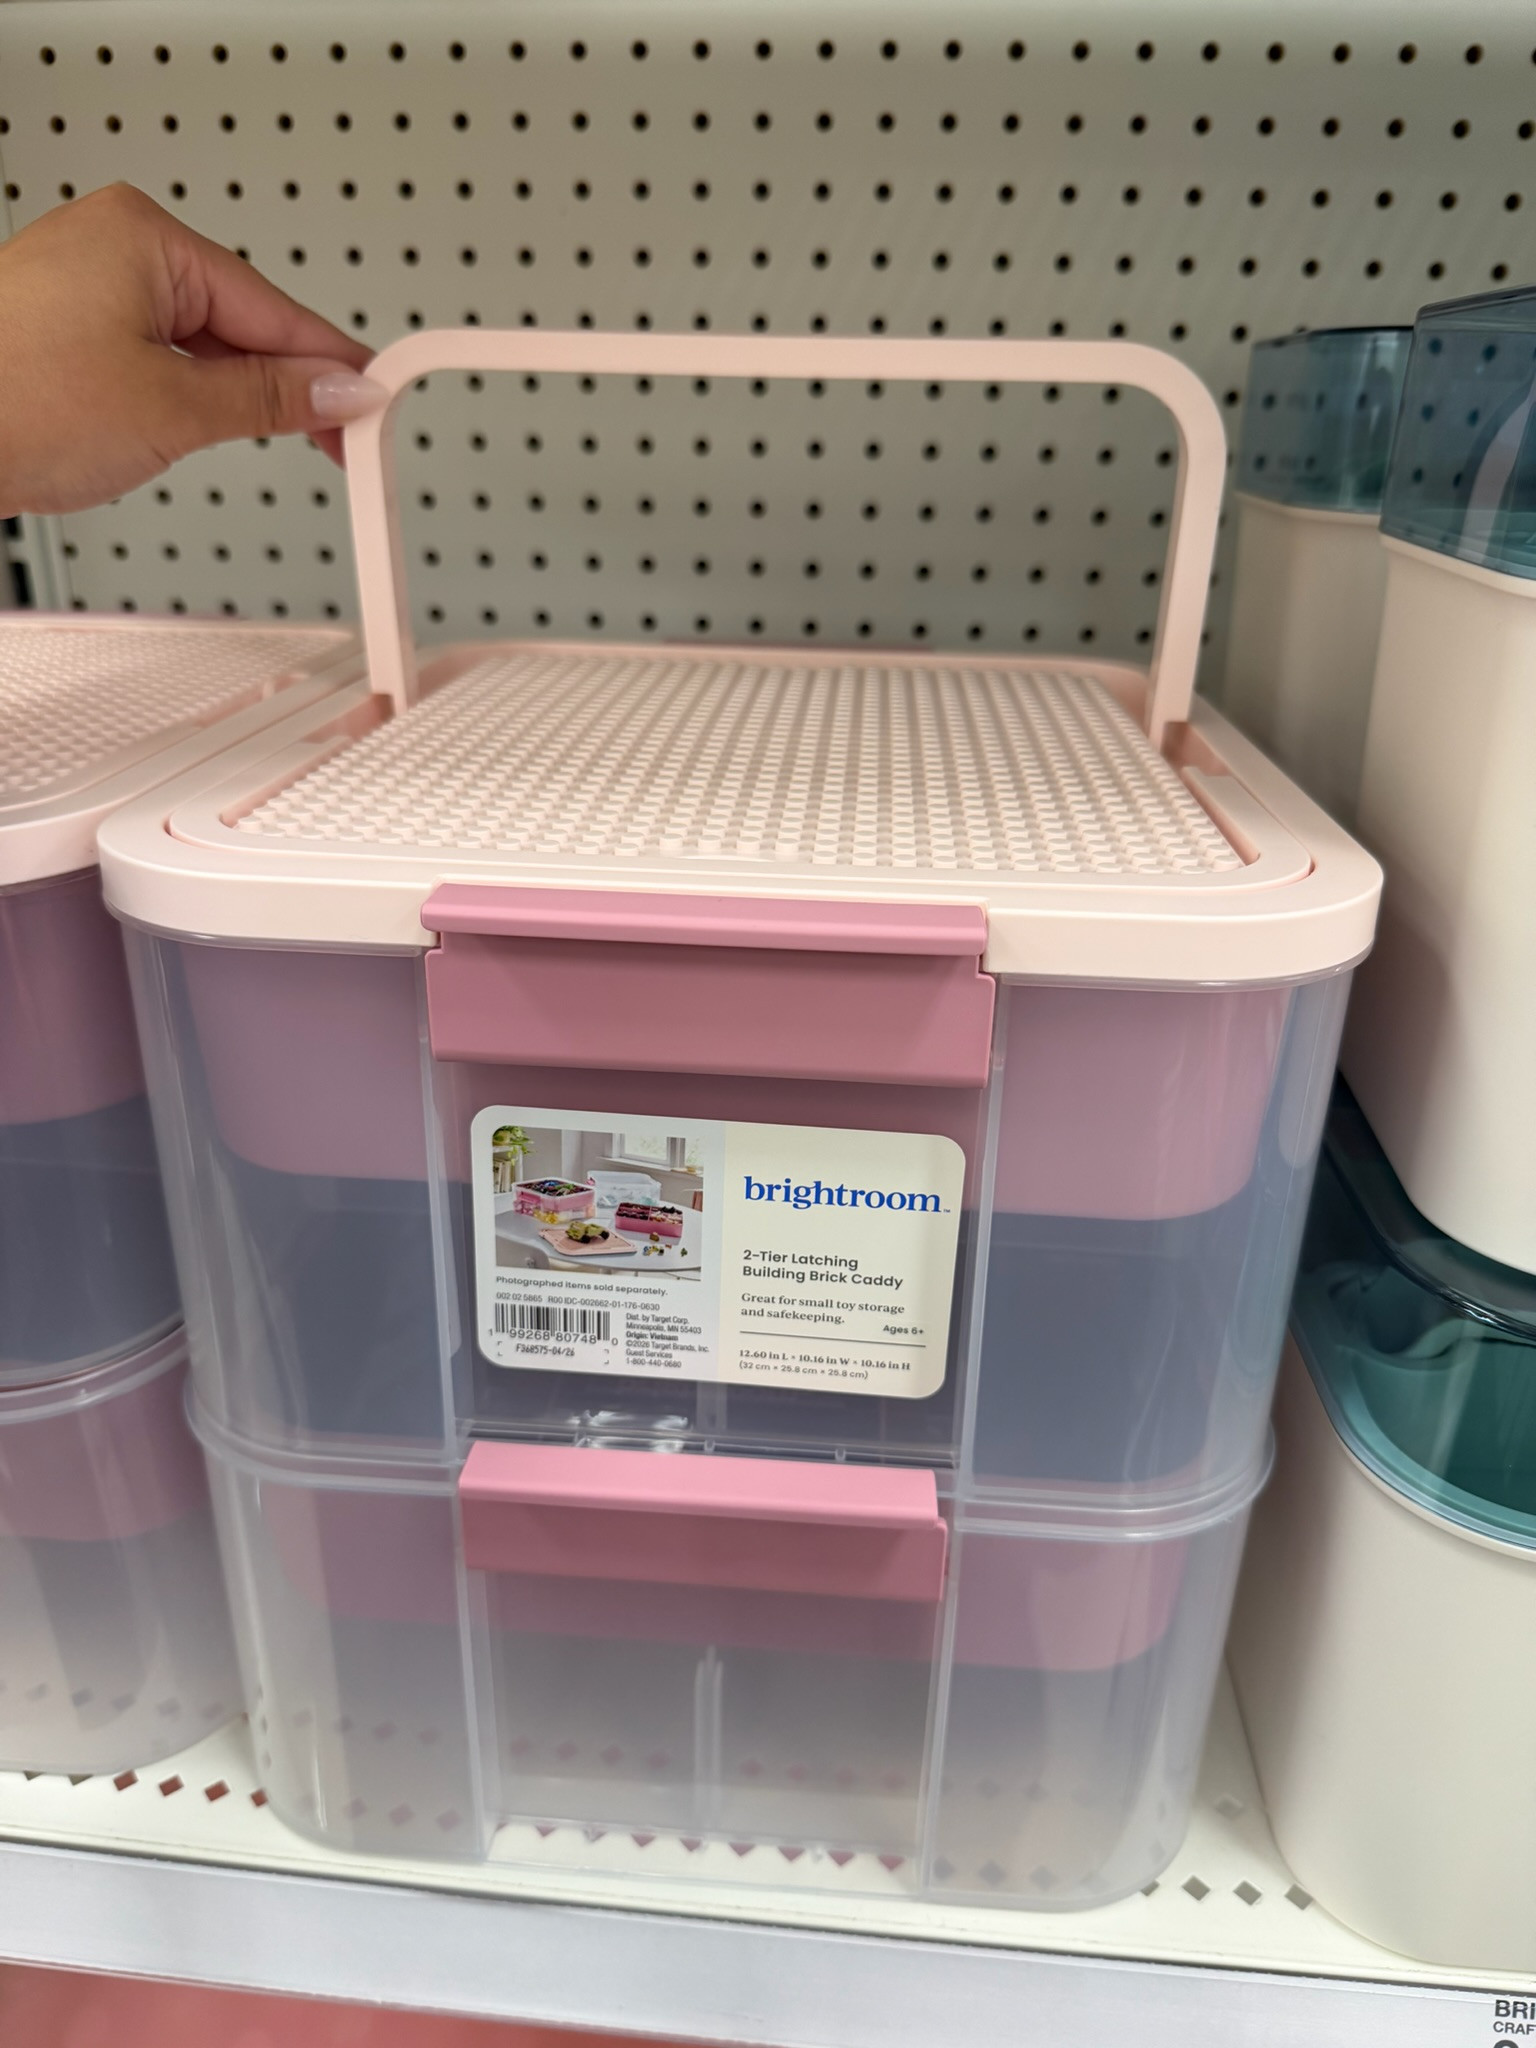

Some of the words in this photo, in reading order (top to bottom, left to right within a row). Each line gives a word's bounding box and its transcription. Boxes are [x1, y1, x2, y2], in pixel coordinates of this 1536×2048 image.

[743, 1250, 787, 1263] 2-Tier
[792, 1253, 858, 1270] Latching
[743, 1266, 805, 1283] Building
[810, 1270, 847, 1283] Brick
[852, 1274, 903, 1289] Caddy
[496, 1276, 563, 1288] Photographed
[565, 1281, 591, 1290] items
[616, 1286, 668, 1296] separately.
[496, 1292, 510, 1300] 002
[741, 1293, 776, 1304] Great
[779, 1295, 796, 1305] for
[799, 1297, 833, 1308] small
[837, 1300, 855, 1311] toy
[859, 1302, 904, 1314] storage
[642, 1314, 649, 1322] by
[652, 1315, 671, 1323] Target
[673, 1316, 689, 1324] Corp.
[741, 1308, 764, 1317] and
[767, 1309, 845, 1324] safekeeping.
[626, 1322, 665, 1332] Minneapolis,
[883, 1325, 908, 1334] Ages
[510, 1329, 550, 1340] 99268
[556, 1332, 596, 1344] 80748
[650, 1333, 678, 1341] Vietnam
[652, 1342, 671, 1350] Target
[646, 1350, 672, 1358] Services
[740, 1350, 767, 1358] 12.60
[769, 1352, 780, 1360] in
[799, 1354, 824, 1363] 10.16
[826, 1356, 837, 1364] in
[861, 1360, 886, 1368] 10.16
[781, 1365, 800, 1373] 25.8
[828, 1369, 847, 1377] 25.8
[850, 1371, 868, 1379] cm)
[1495, 1999, 1535, 2020] BRI
